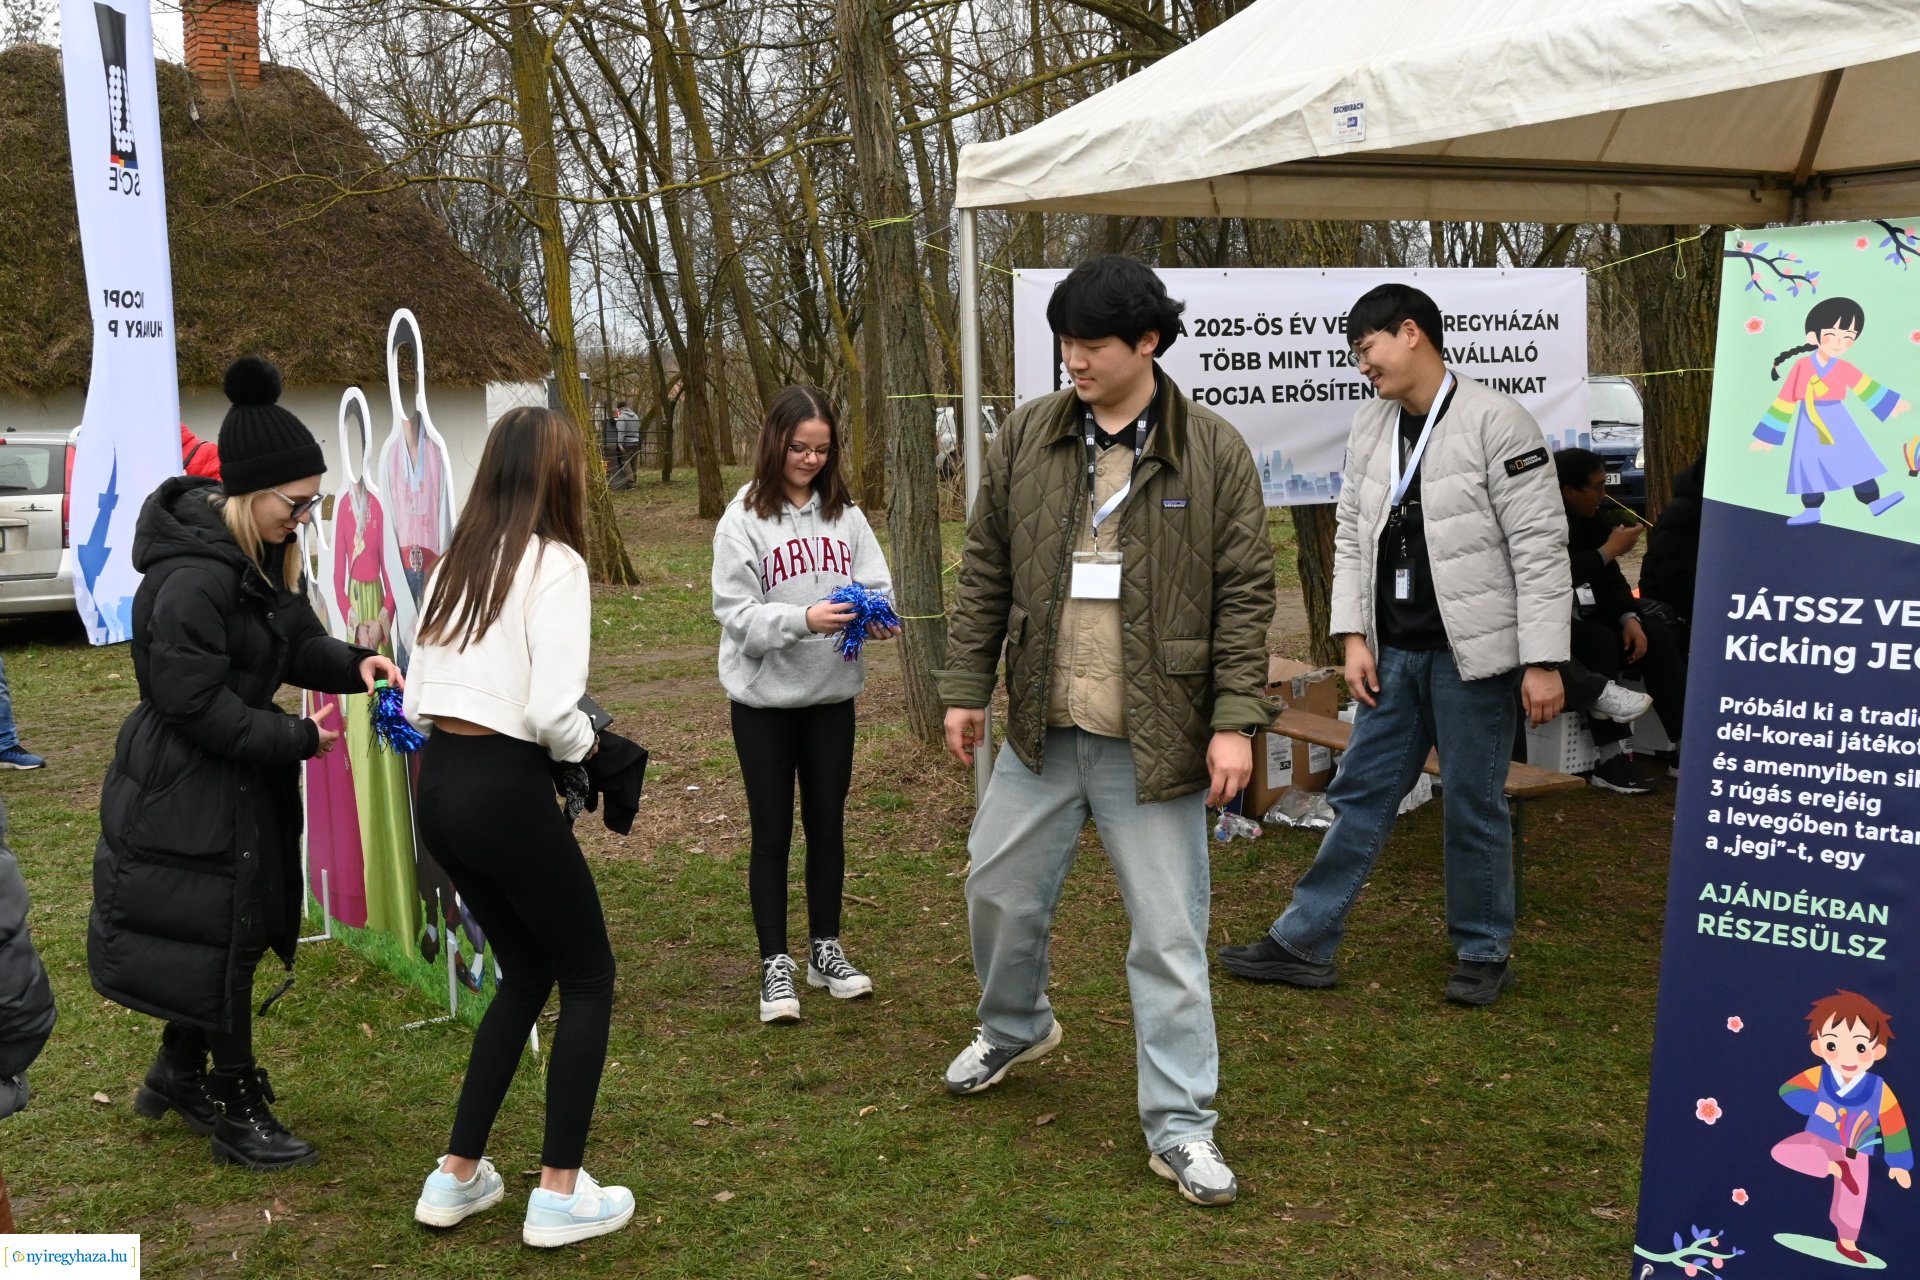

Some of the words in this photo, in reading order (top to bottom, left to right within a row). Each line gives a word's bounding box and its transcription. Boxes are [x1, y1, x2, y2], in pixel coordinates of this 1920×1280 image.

[1193, 313, 1284, 338] 2025-ÖS
[1289, 311, 1317, 335] ÉV
[1440, 309, 1560, 332] REGYHÁZÁN
[1199, 347, 1262, 372] TÖBB
[1268, 350, 1322, 370] MINT
[1192, 386, 1266, 406] FOGJA
[1727, 586, 1864, 625] JÁTSSZ
[1874, 599, 1920, 627] VE
[1725, 634, 1857, 674] Kicking
[1867, 641, 1920, 671] JE
[1719, 696, 1807, 719] Próbáld
[1812, 702, 1834, 721] ki
[1839, 708, 1853, 722] a
[1860, 706, 1920, 727] tradi
[1716, 722, 1834, 748] dél-koreai
[1712, 752, 1738, 771] és
[1743, 758, 1888, 785] amennyiben
[1710, 779, 1723, 796] 3
[1729, 781, 1792, 805] rúgás
[1798, 790, 1882, 817] erejéig
[1707, 809, 1720, 823] a
[1726, 806, 1848, 837] levegőben
[1705, 835, 1718, 849] a
[1820, 849, 1865, 871] egy
[1698, 881, 1889, 926] AJÁNDÉKBAN
[1697, 910, 1887, 961] RÉSZESÜLSZ
